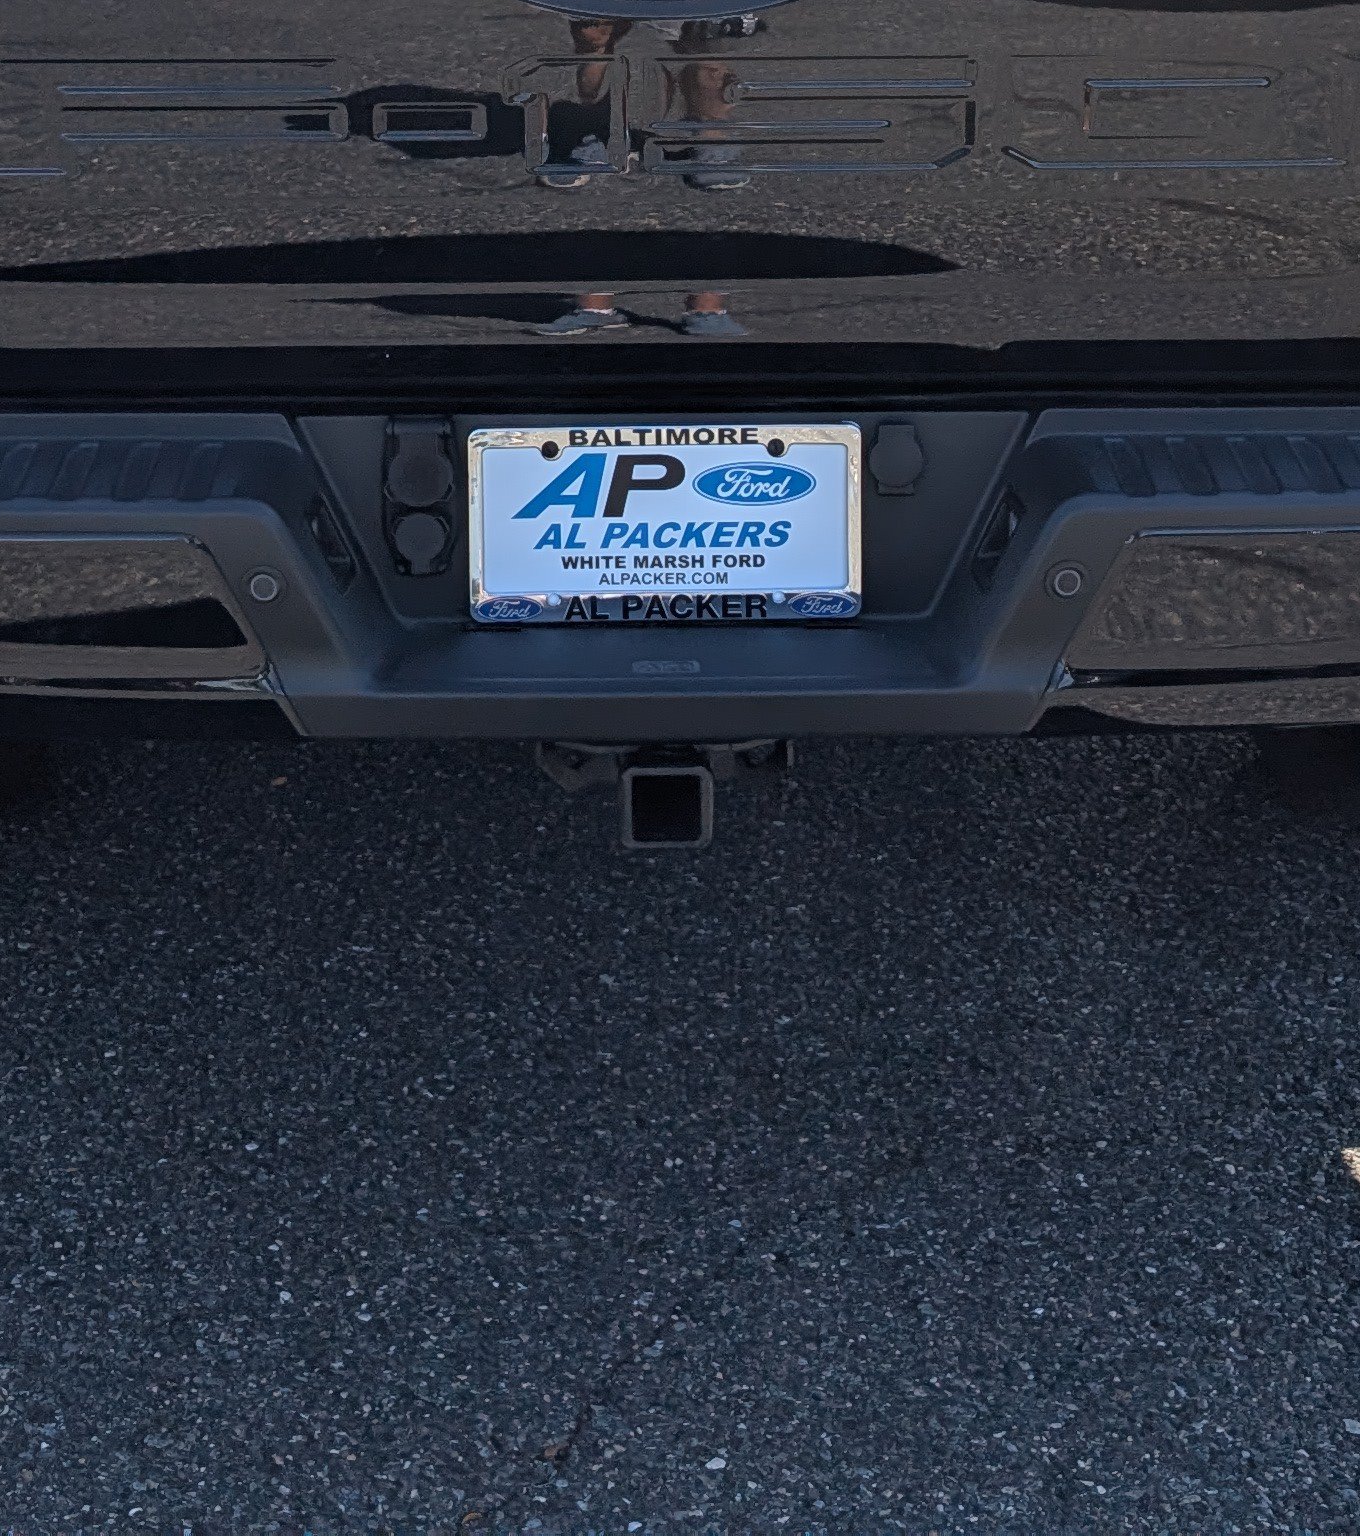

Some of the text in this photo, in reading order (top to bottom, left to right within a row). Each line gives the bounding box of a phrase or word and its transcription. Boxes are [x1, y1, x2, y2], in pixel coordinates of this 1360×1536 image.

[568, 427, 759, 446] BALTIMORE
[511, 453, 686, 519] AP
[716, 467, 792, 501] Ford
[533, 521, 792, 549] AL PACKERS
[561, 554, 766, 570] WHITE MARSH FORD
[598, 571, 729, 586] ALPACKER.COM
[488, 600, 532, 618] Ford
[564, 594, 768, 620] AL PACKER
[800, 596, 845, 615] Ford
